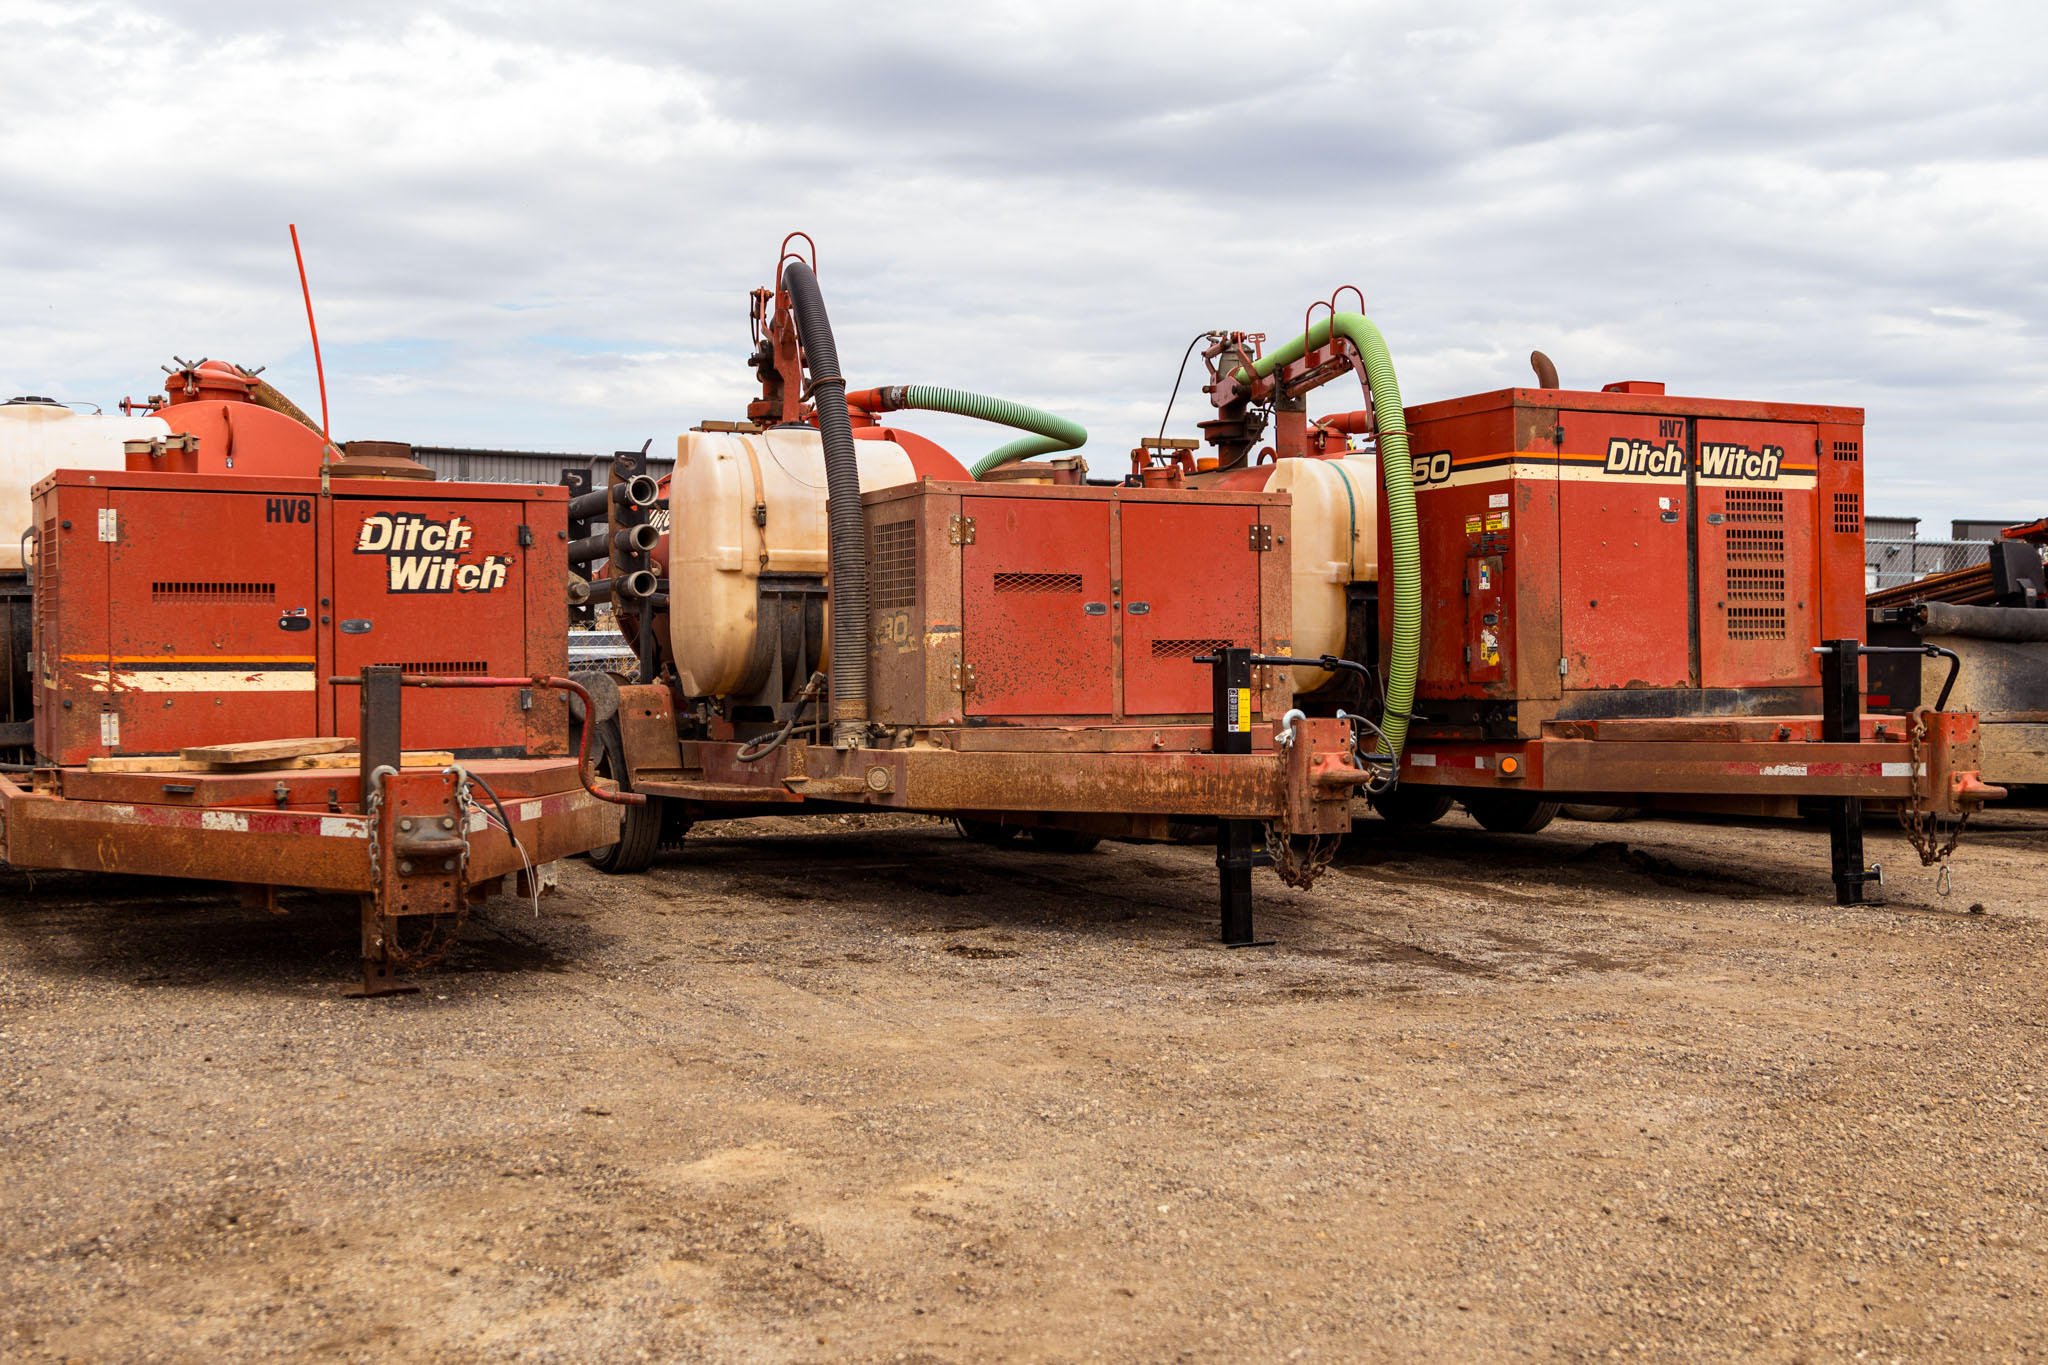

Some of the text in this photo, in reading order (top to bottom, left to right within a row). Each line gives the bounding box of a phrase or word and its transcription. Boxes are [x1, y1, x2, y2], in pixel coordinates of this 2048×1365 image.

[1659, 419, 1684, 438] HV7
[1412, 453, 1451, 482] 50
[1606, 440, 1779, 478] Ditch Witch
[266, 498, 311, 524] HV8
[357, 515, 473, 552] Ditch
[389, 554, 508, 591] Witch
